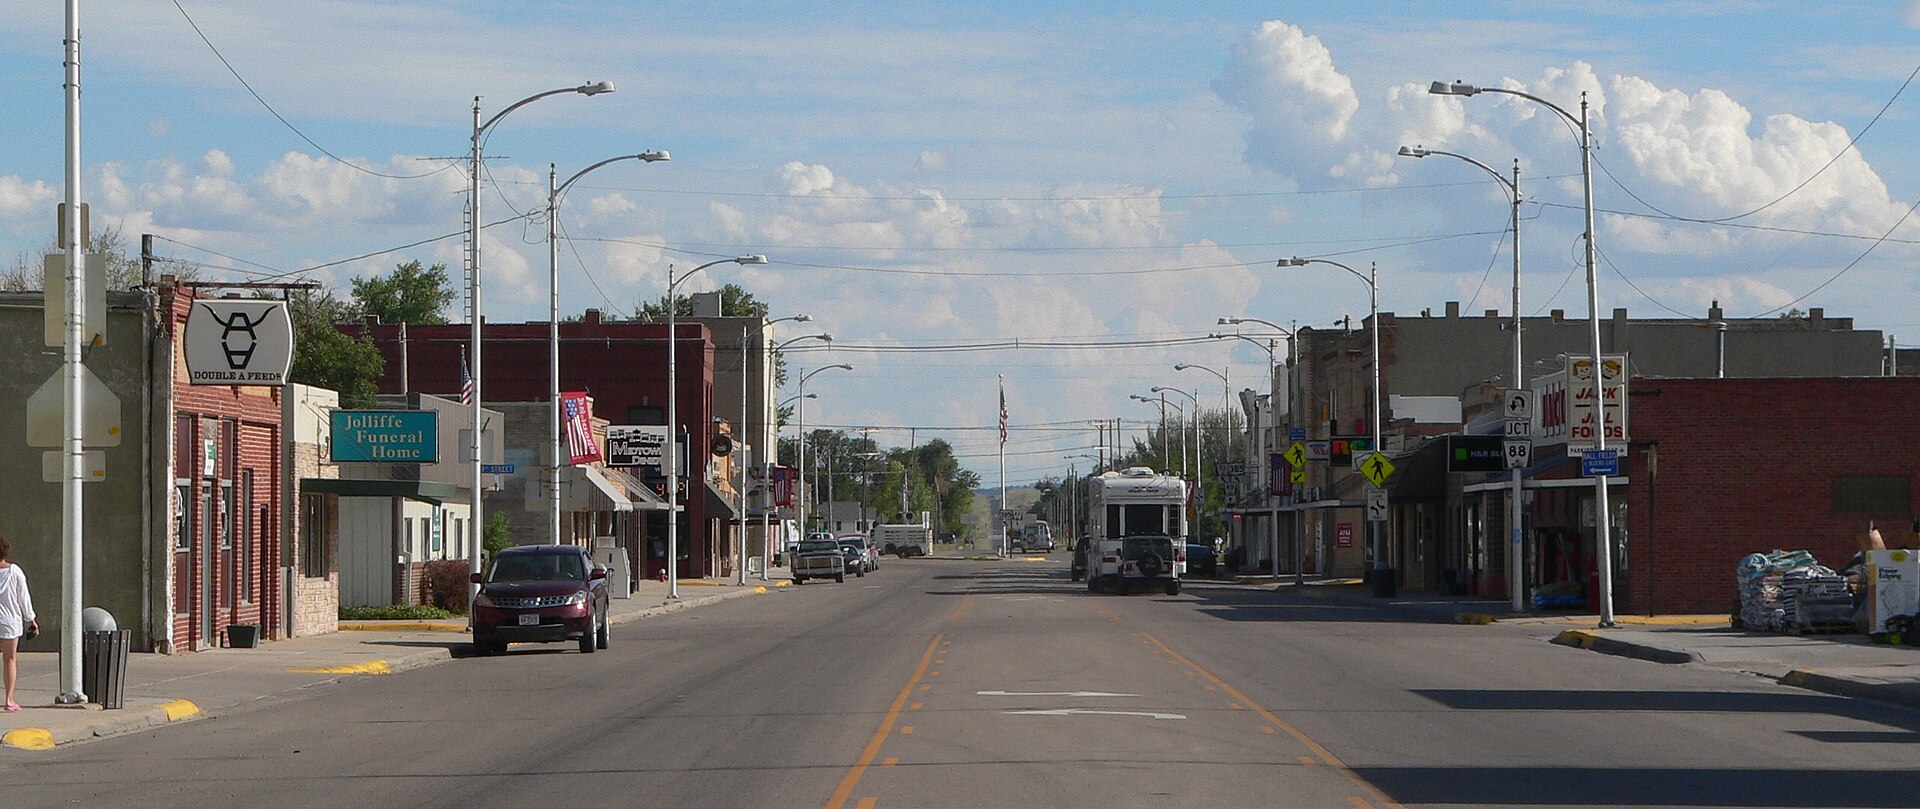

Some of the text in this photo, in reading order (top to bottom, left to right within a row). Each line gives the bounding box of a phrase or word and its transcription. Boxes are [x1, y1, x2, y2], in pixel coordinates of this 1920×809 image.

[194, 371, 282, 381] DOUBLE A FEEDS
[345, 415, 403, 431] Jolliffe
[1581, 412, 1613, 424] JL
[1507, 422, 1529, 435] JCT
[1571, 426, 1623, 438] FODS
[356, 430, 423, 443] Funeral
[371, 446, 420, 458] Home
[612, 441, 662, 455] MIDTOW
[1508, 445, 1526, 458] 88
